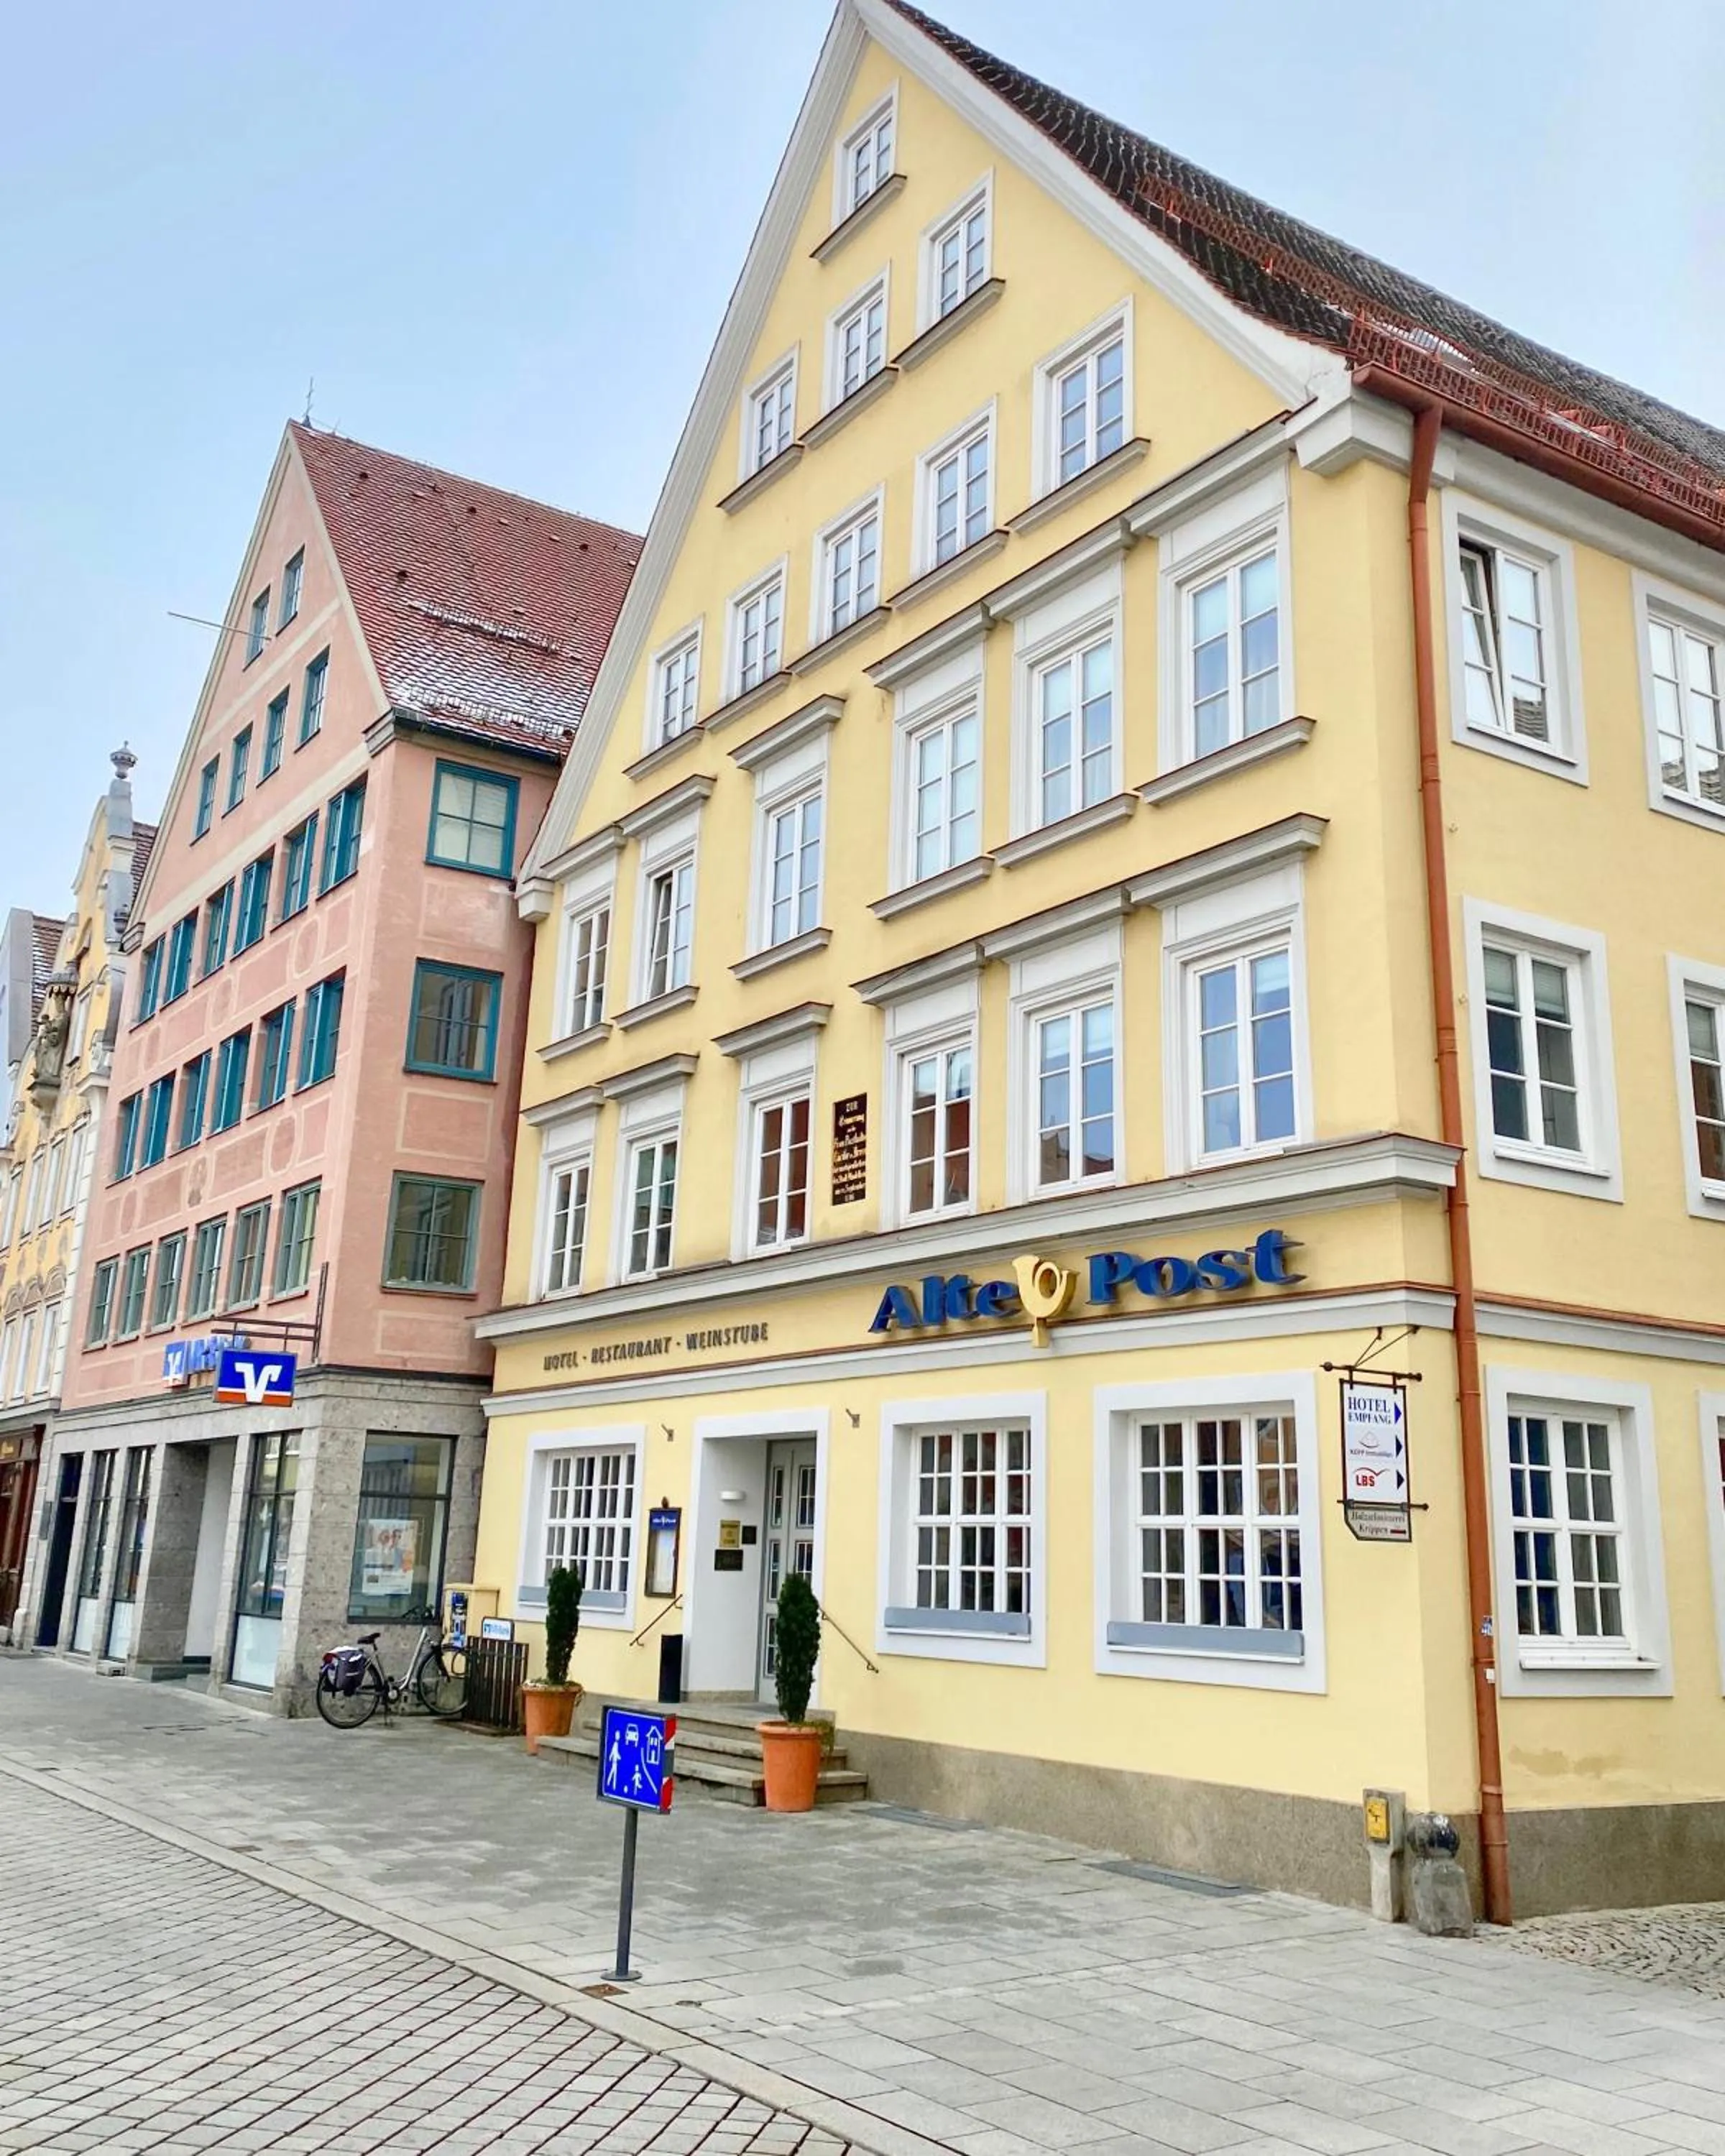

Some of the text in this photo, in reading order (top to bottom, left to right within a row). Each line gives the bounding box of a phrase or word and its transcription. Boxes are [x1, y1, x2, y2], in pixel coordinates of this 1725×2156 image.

[868, 1230, 1308, 1333] Alte Post
[543, 1322, 769, 1370] HOTEL RESTAURANT WEINSTUBE
[1348, 1396, 1391, 1413] HOTEL
[1348, 1411, 1392, 1424] EMPFANG
[1356, 1474, 1375, 1487] LBS
